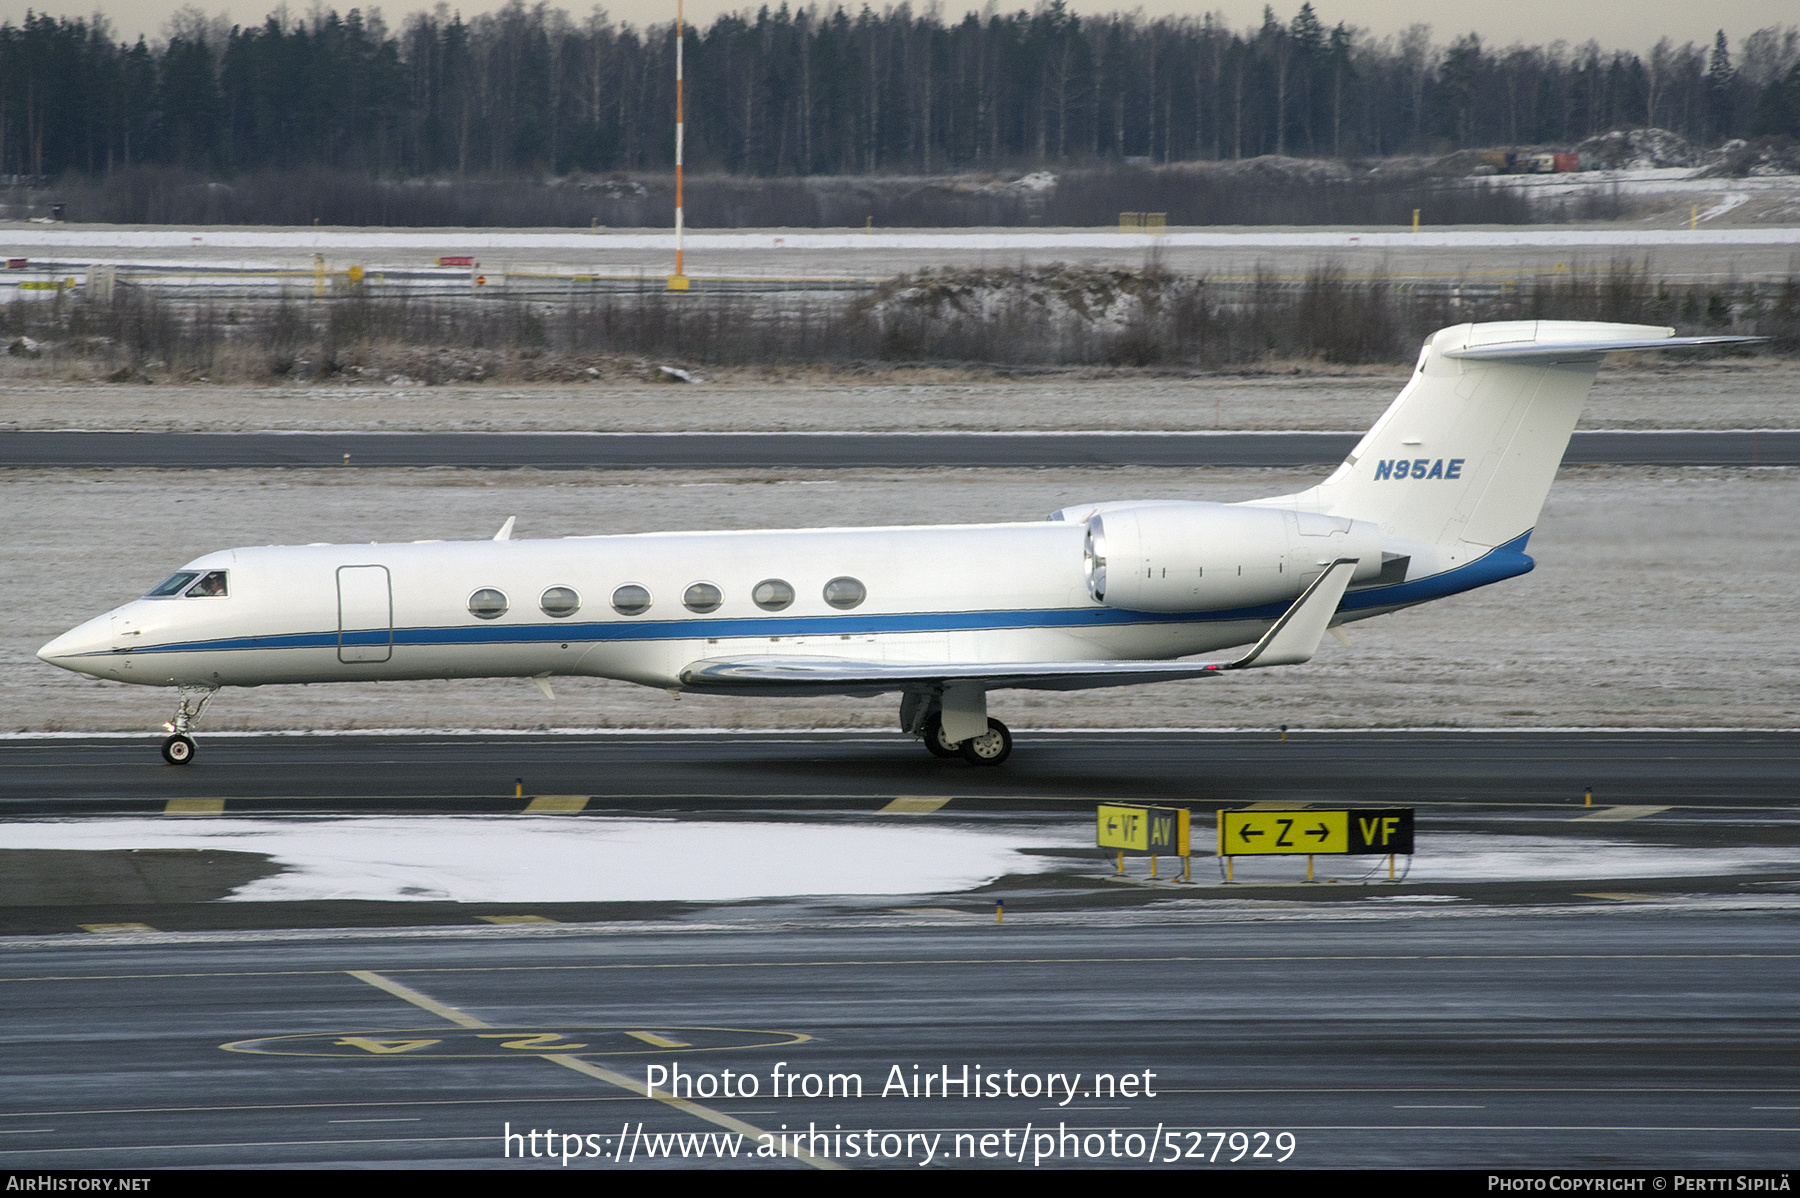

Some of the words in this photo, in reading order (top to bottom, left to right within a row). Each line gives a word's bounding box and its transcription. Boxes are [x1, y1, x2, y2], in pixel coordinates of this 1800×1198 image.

[1373, 458, 1466, 481] N95AE
[1120, 813, 1139, 843] VF
[1151, 816, 1172, 846] AV
[1276, 818, 1294, 847] Z
[1357, 816, 1401, 846] VF
